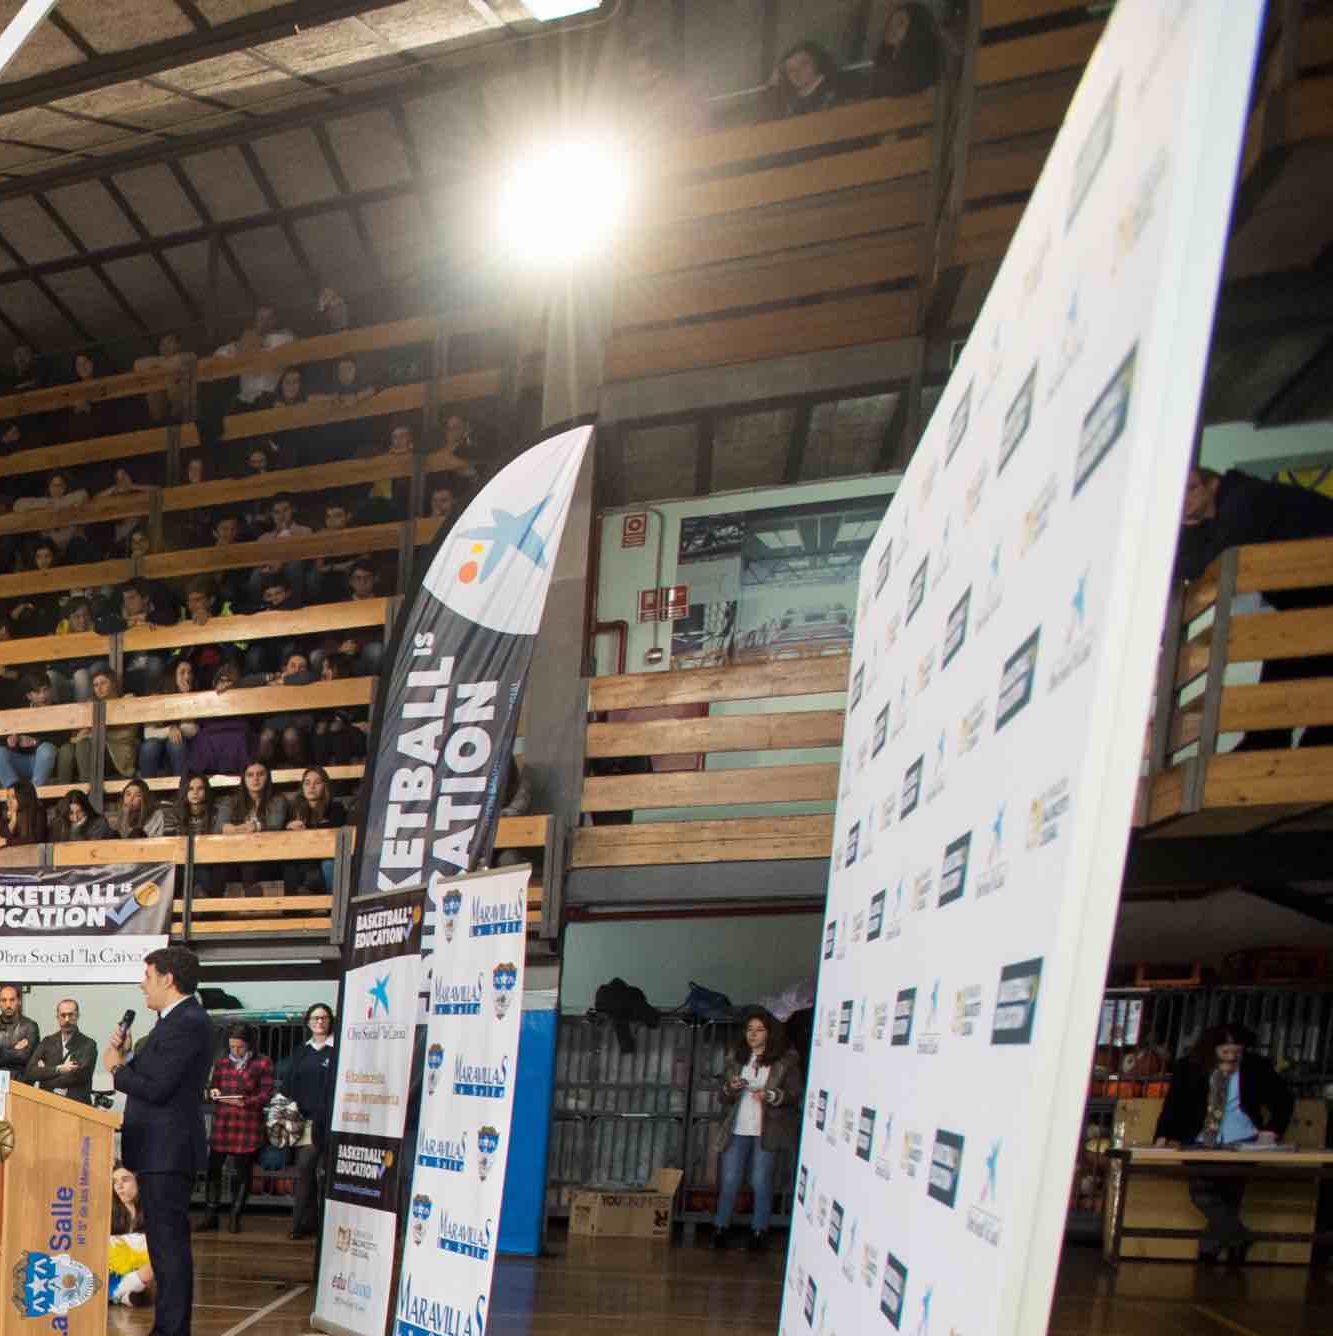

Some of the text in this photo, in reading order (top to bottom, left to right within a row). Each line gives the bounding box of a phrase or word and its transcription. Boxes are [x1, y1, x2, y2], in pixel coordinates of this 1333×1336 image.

[377, 655, 455, 892] KETBALL
[120, 883, 133, 893] IS
[356, 906, 408, 931] BASKETBALL
[355, 926, 405, 949] EDUCATION
[31, 948, 75, 964] Social
[338, 1144, 381, 1163] BASKETBALL
[336, 1159, 378, 1180] EDUCATION
[49, 1185, 75, 1251] Salle
[439, 1208, 493, 1248] MARAVILLAS
